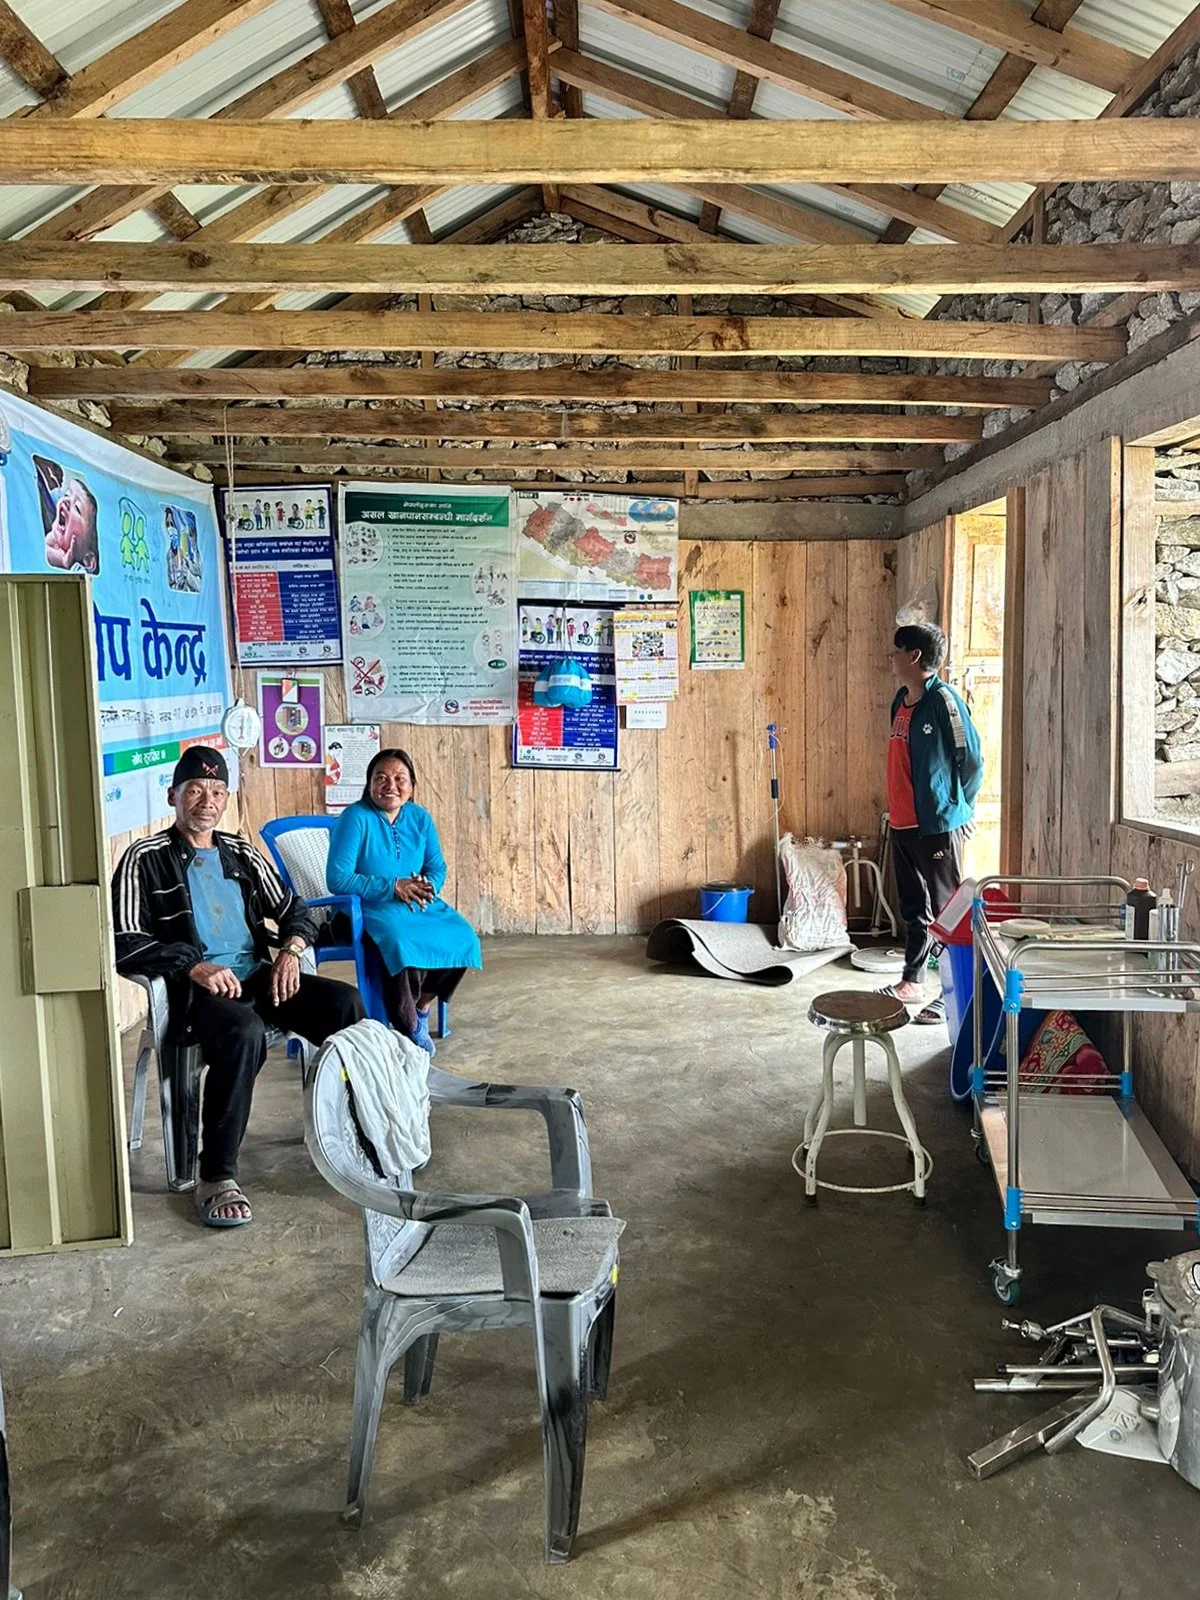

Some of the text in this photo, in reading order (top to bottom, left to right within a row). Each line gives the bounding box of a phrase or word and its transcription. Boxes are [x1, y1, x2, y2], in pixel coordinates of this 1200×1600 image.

[361, 510, 384, 519] असल
[93, 600, 131, 681] ोप
[140, 598, 207, 687] केन्द्र
